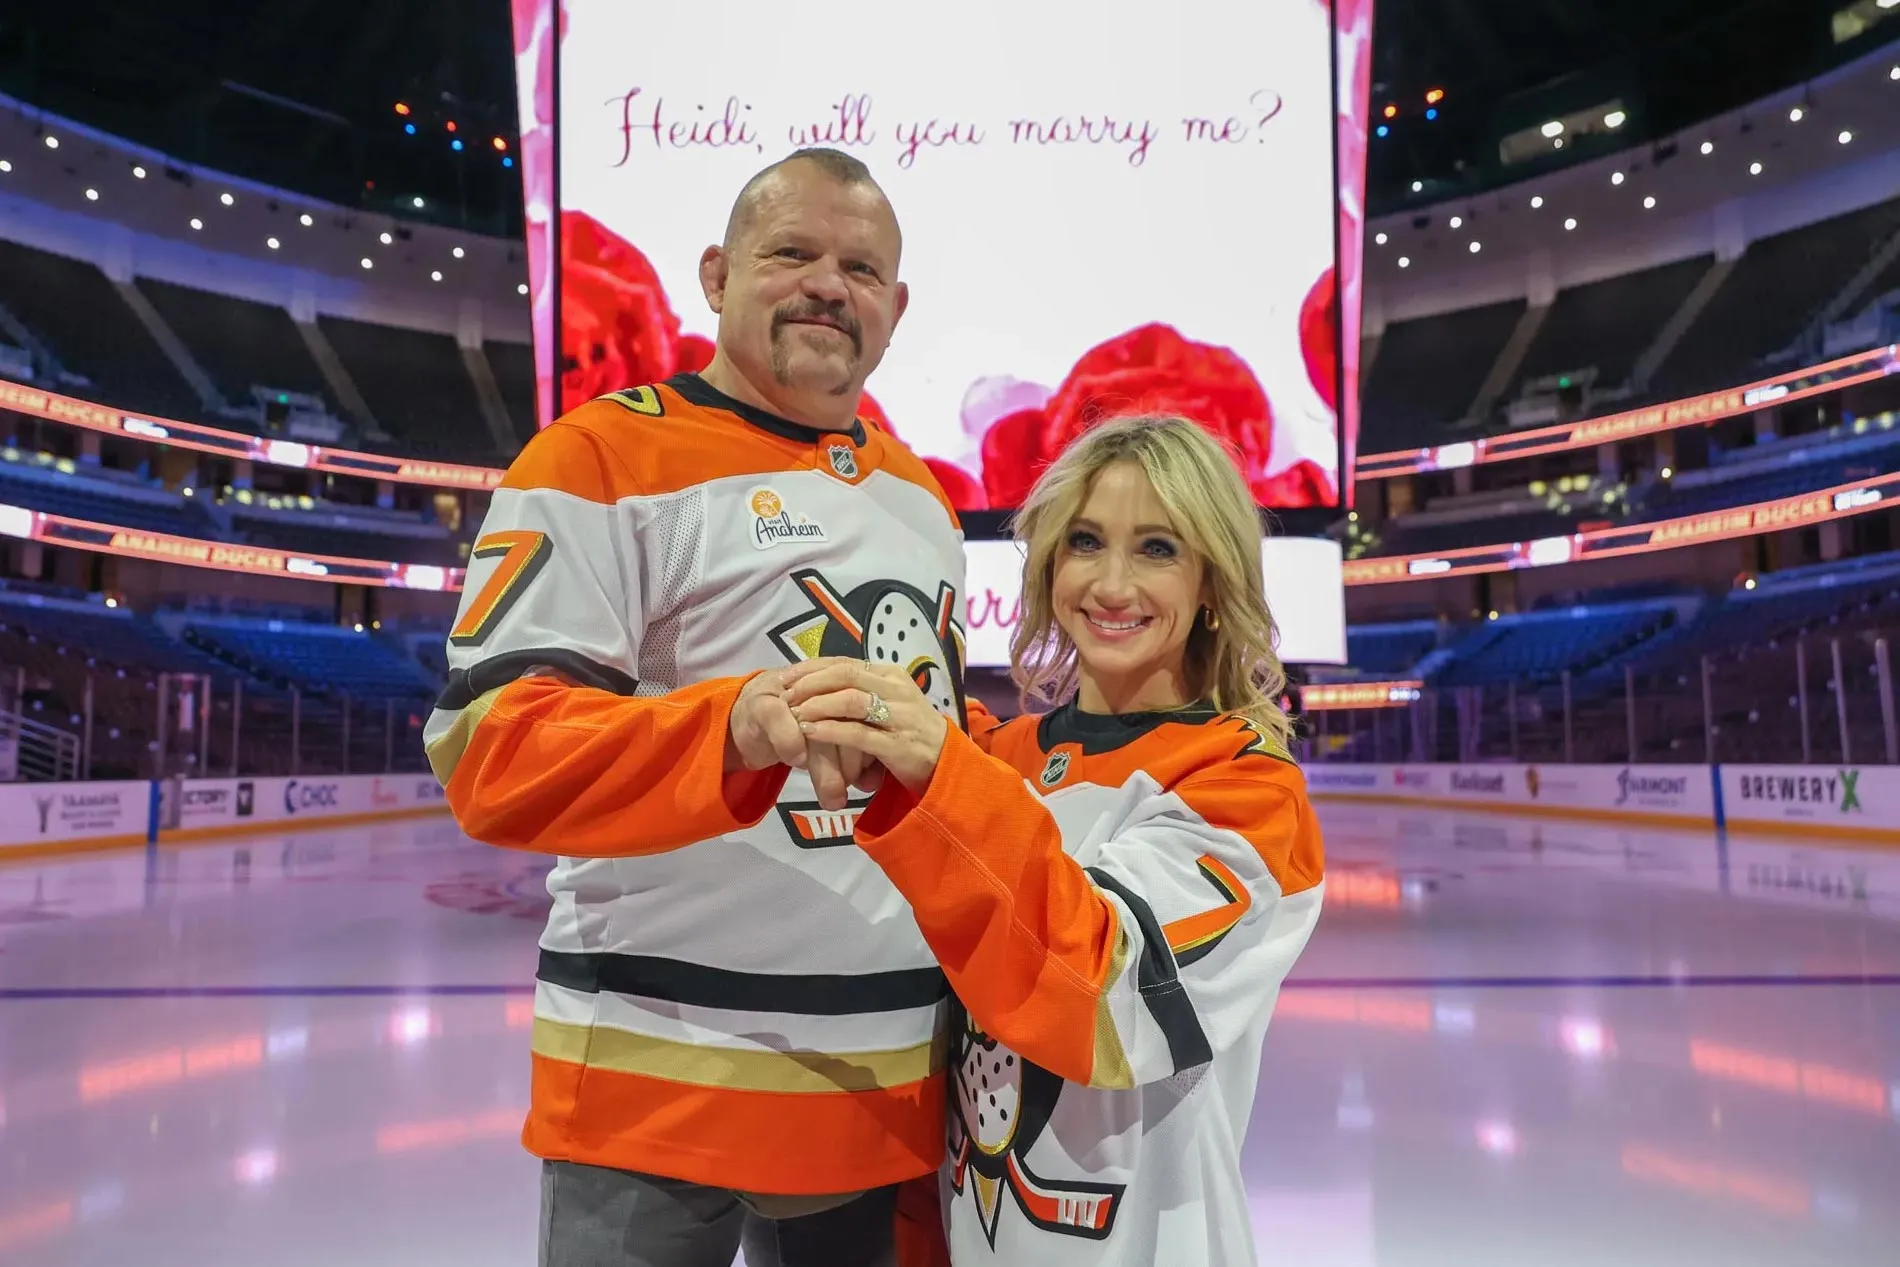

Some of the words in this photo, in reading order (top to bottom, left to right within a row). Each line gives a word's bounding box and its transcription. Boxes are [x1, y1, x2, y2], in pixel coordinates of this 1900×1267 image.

[603, 86, 764, 168] Heidi,
[788, 93, 876, 147] will
[896, 118, 987, 170] you
[1008, 115, 1159, 168] marry
[1181, 88, 1283, 144] me?
[756, 510, 824, 544] Anaheim
[1650, 510, 1752, 543] ANAHEIM
[1753, 495, 1832, 528] DUCKS
[109, 532, 208, 560] ANAHEIM
[210, 547, 285, 571] DUCKS
[449, 530, 554, 647] 7
[1741, 775, 1836, 802] BREWERY
[1162, 855, 1252, 968] 7
